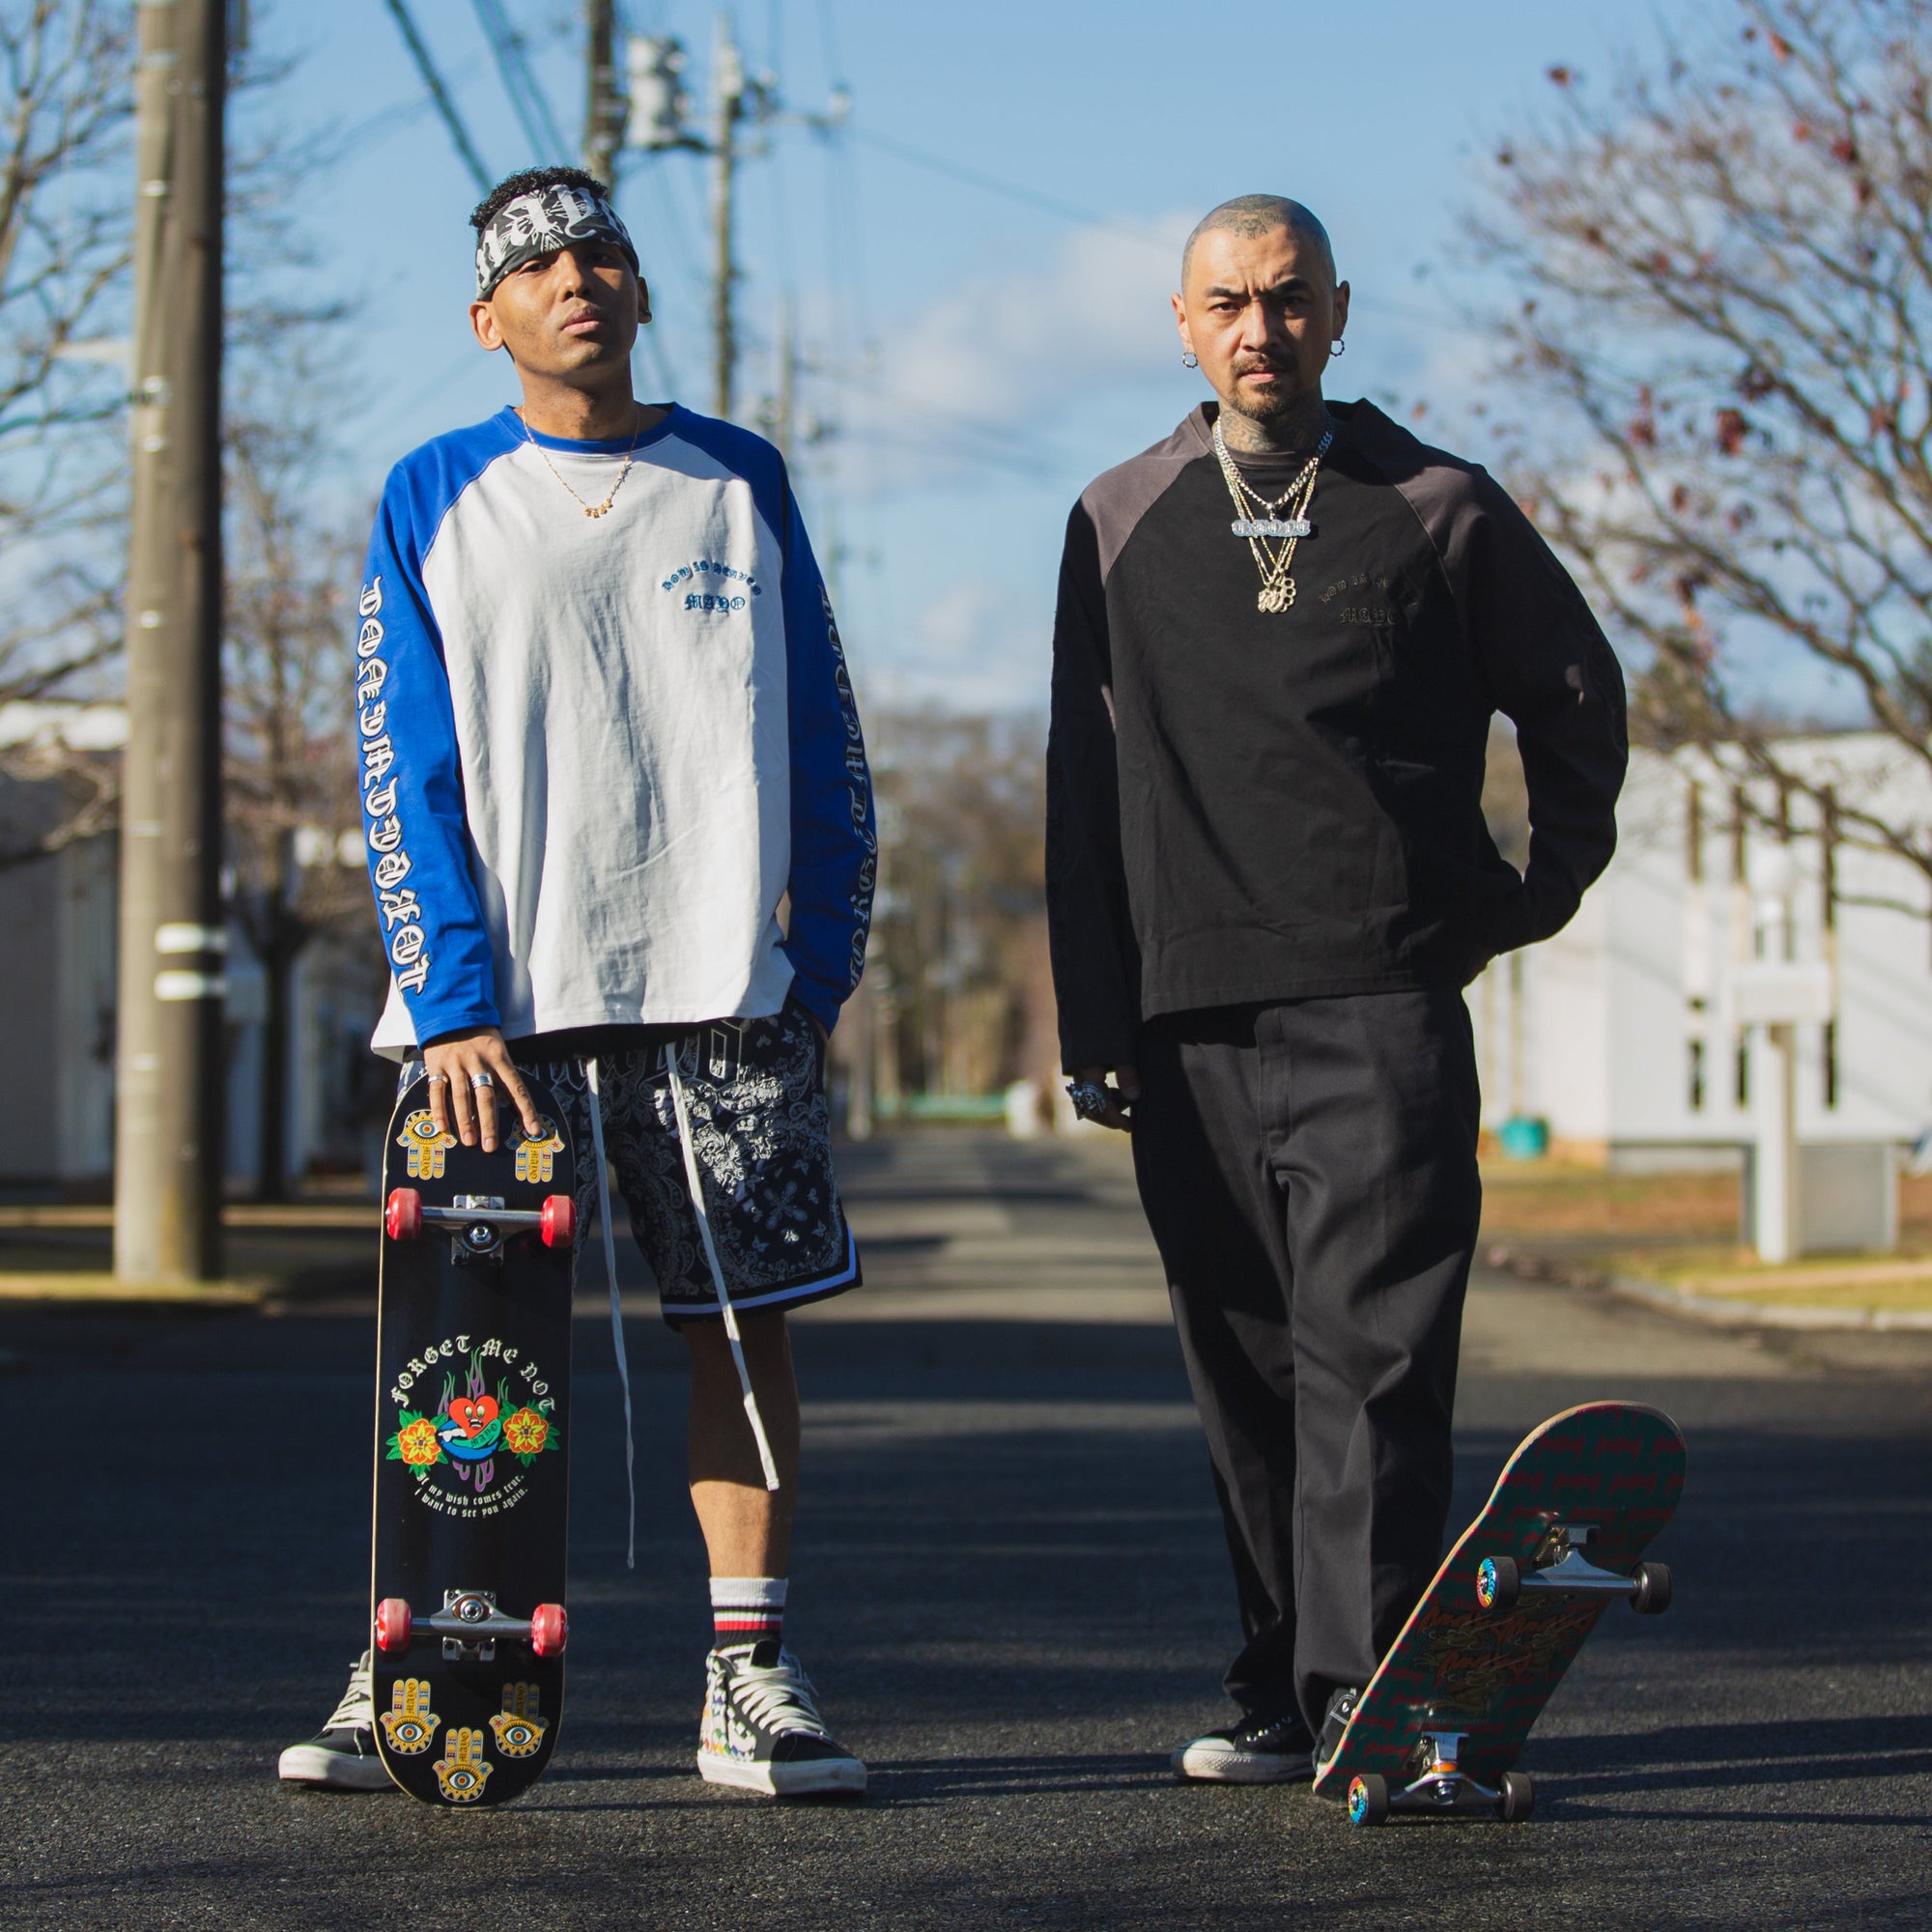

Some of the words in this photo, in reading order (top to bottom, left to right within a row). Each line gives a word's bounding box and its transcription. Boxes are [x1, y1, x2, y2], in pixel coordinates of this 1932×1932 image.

[390, 1335, 471, 1408] FORGET
[480, 1338, 519, 1364] ME
[520, 1362, 555, 1412] NOT
[421, 1492, 444, 1512] want
[446, 1505, 458, 1516] to
[482, 1506, 499, 1519] you
[428, 1484, 442, 1498] my
[445, 1492, 469, 1506] wish
[473, 1490, 502, 1506] comes
